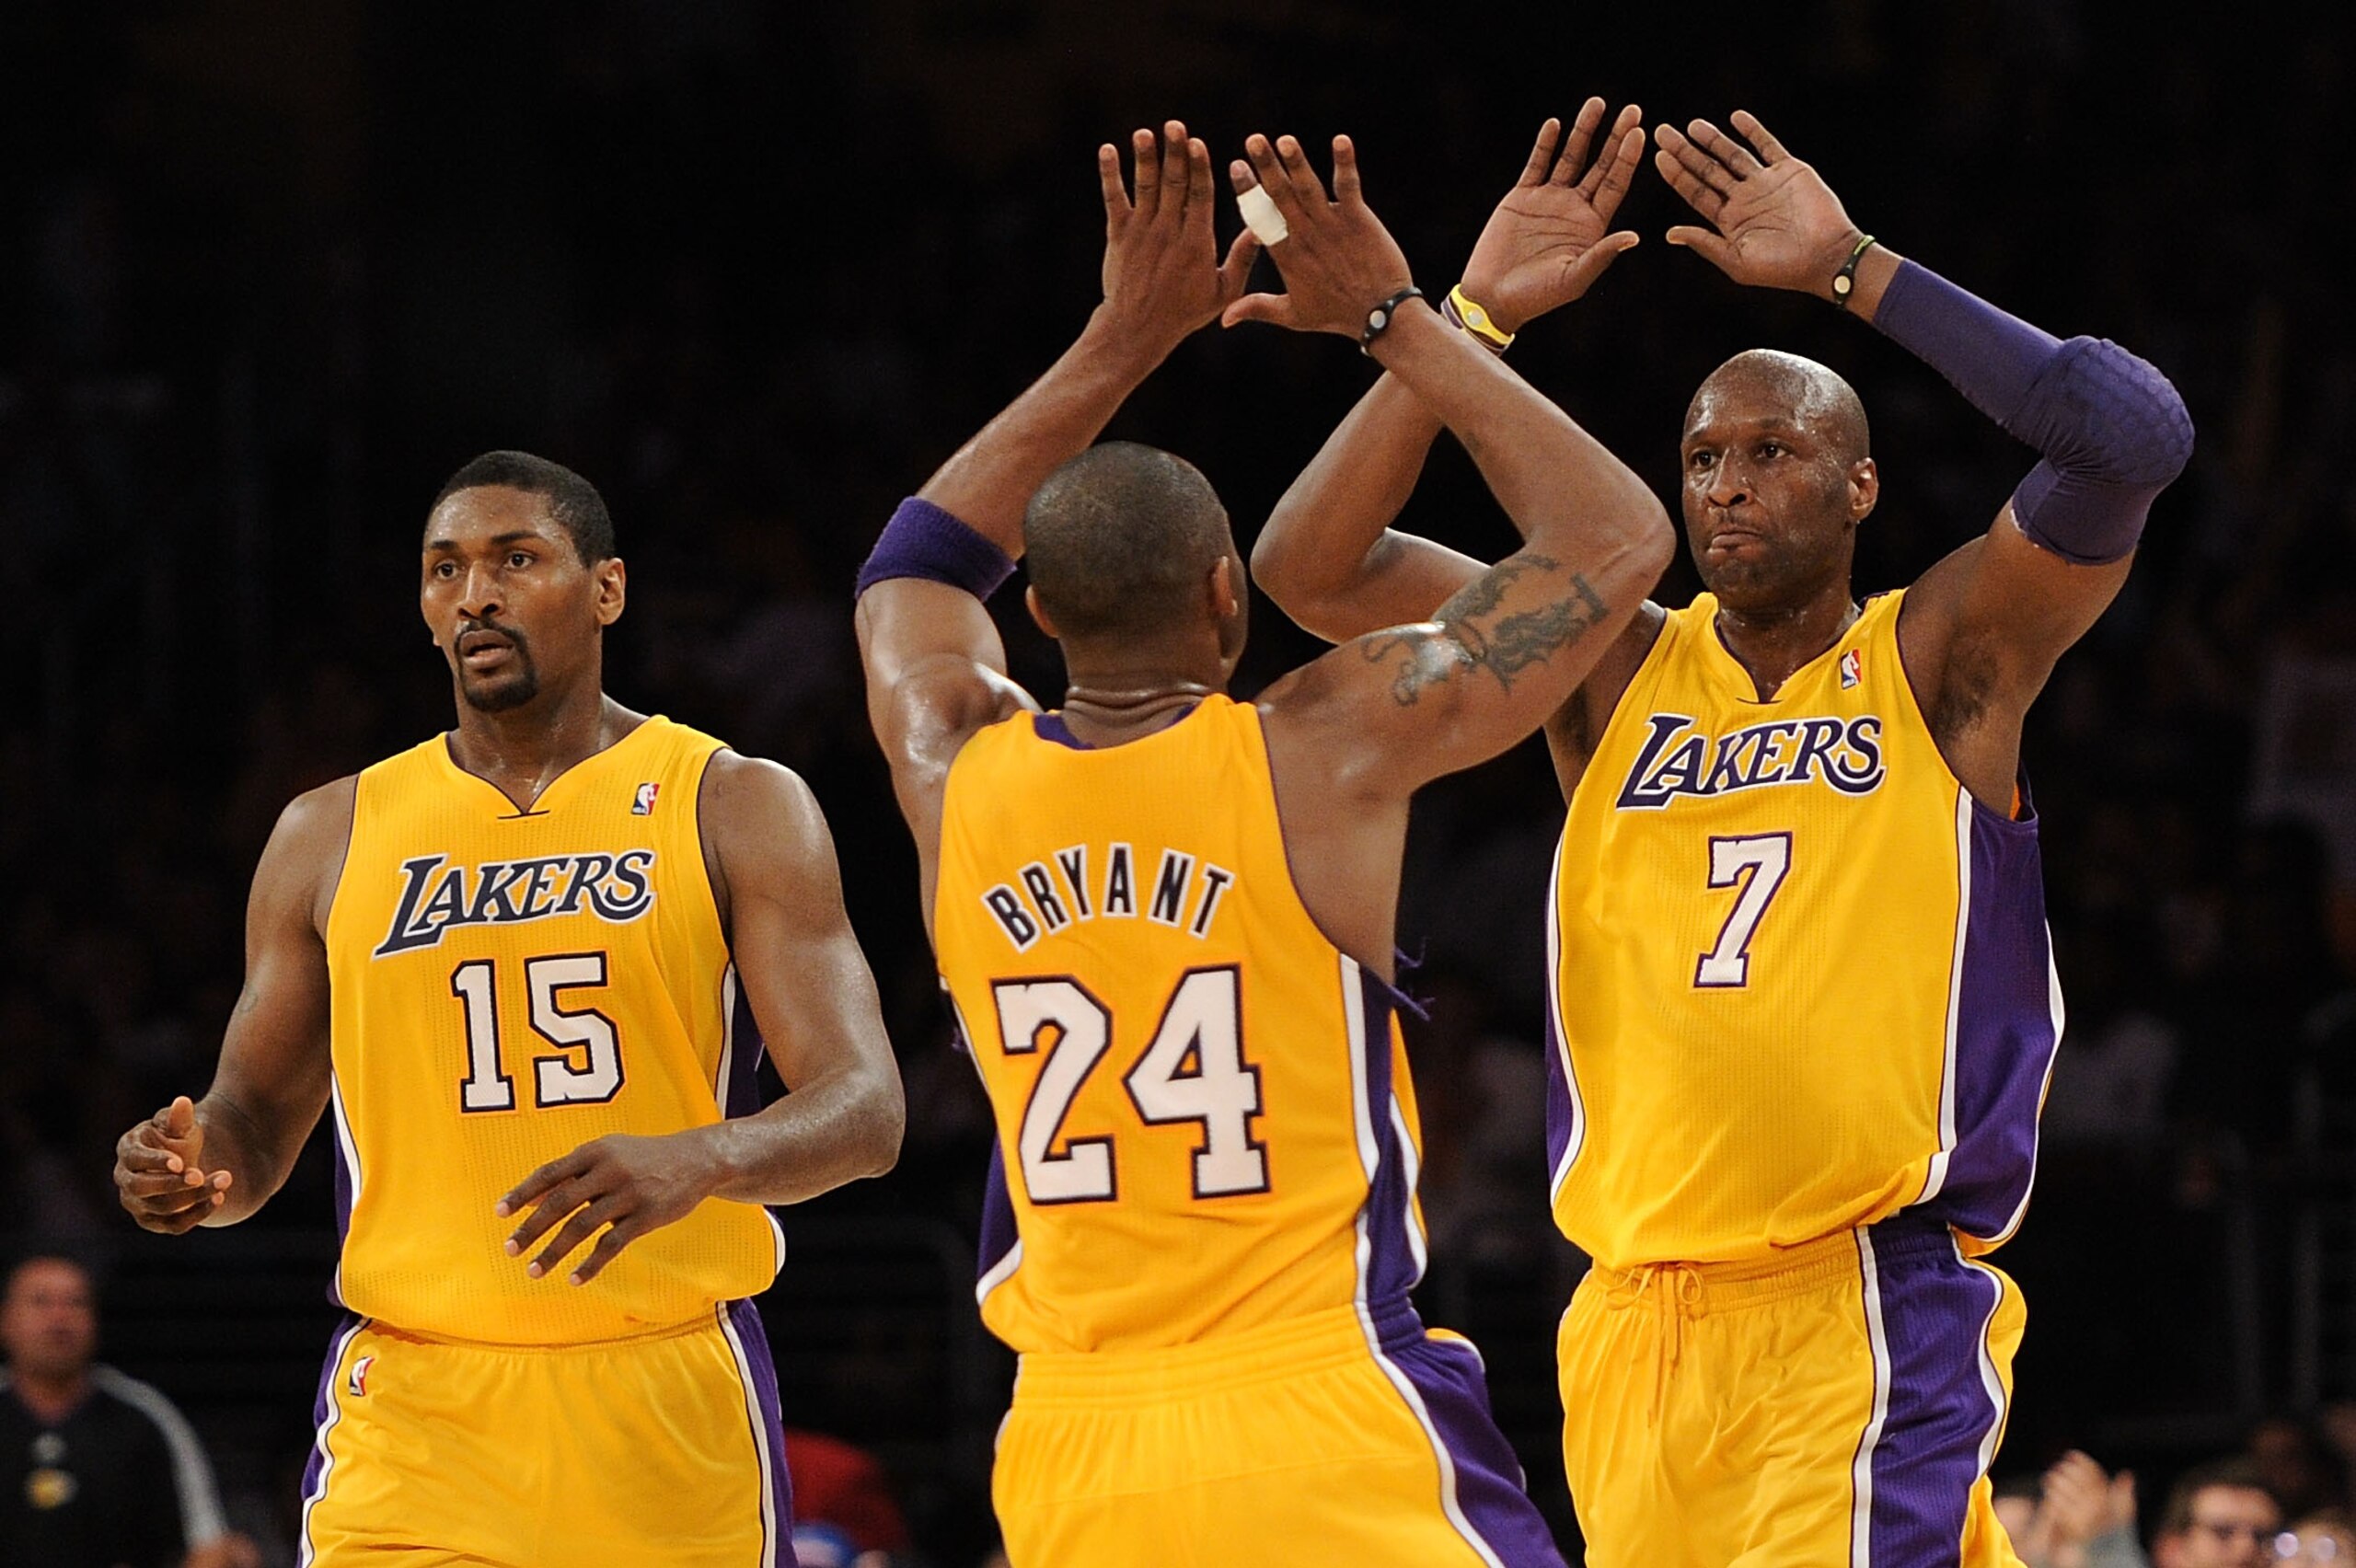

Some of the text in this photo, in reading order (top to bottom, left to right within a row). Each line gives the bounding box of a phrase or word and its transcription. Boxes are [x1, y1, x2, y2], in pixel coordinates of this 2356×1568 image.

[1616, 712, 1887, 812] LAKERS
[372, 849, 658, 961] LAKERS
[981, 842, 1235, 953] BRYANT
[1693, 831, 1793, 987] 7
[450, 951, 625, 1113] 15
[989, 963, 1271, 1205] 24
